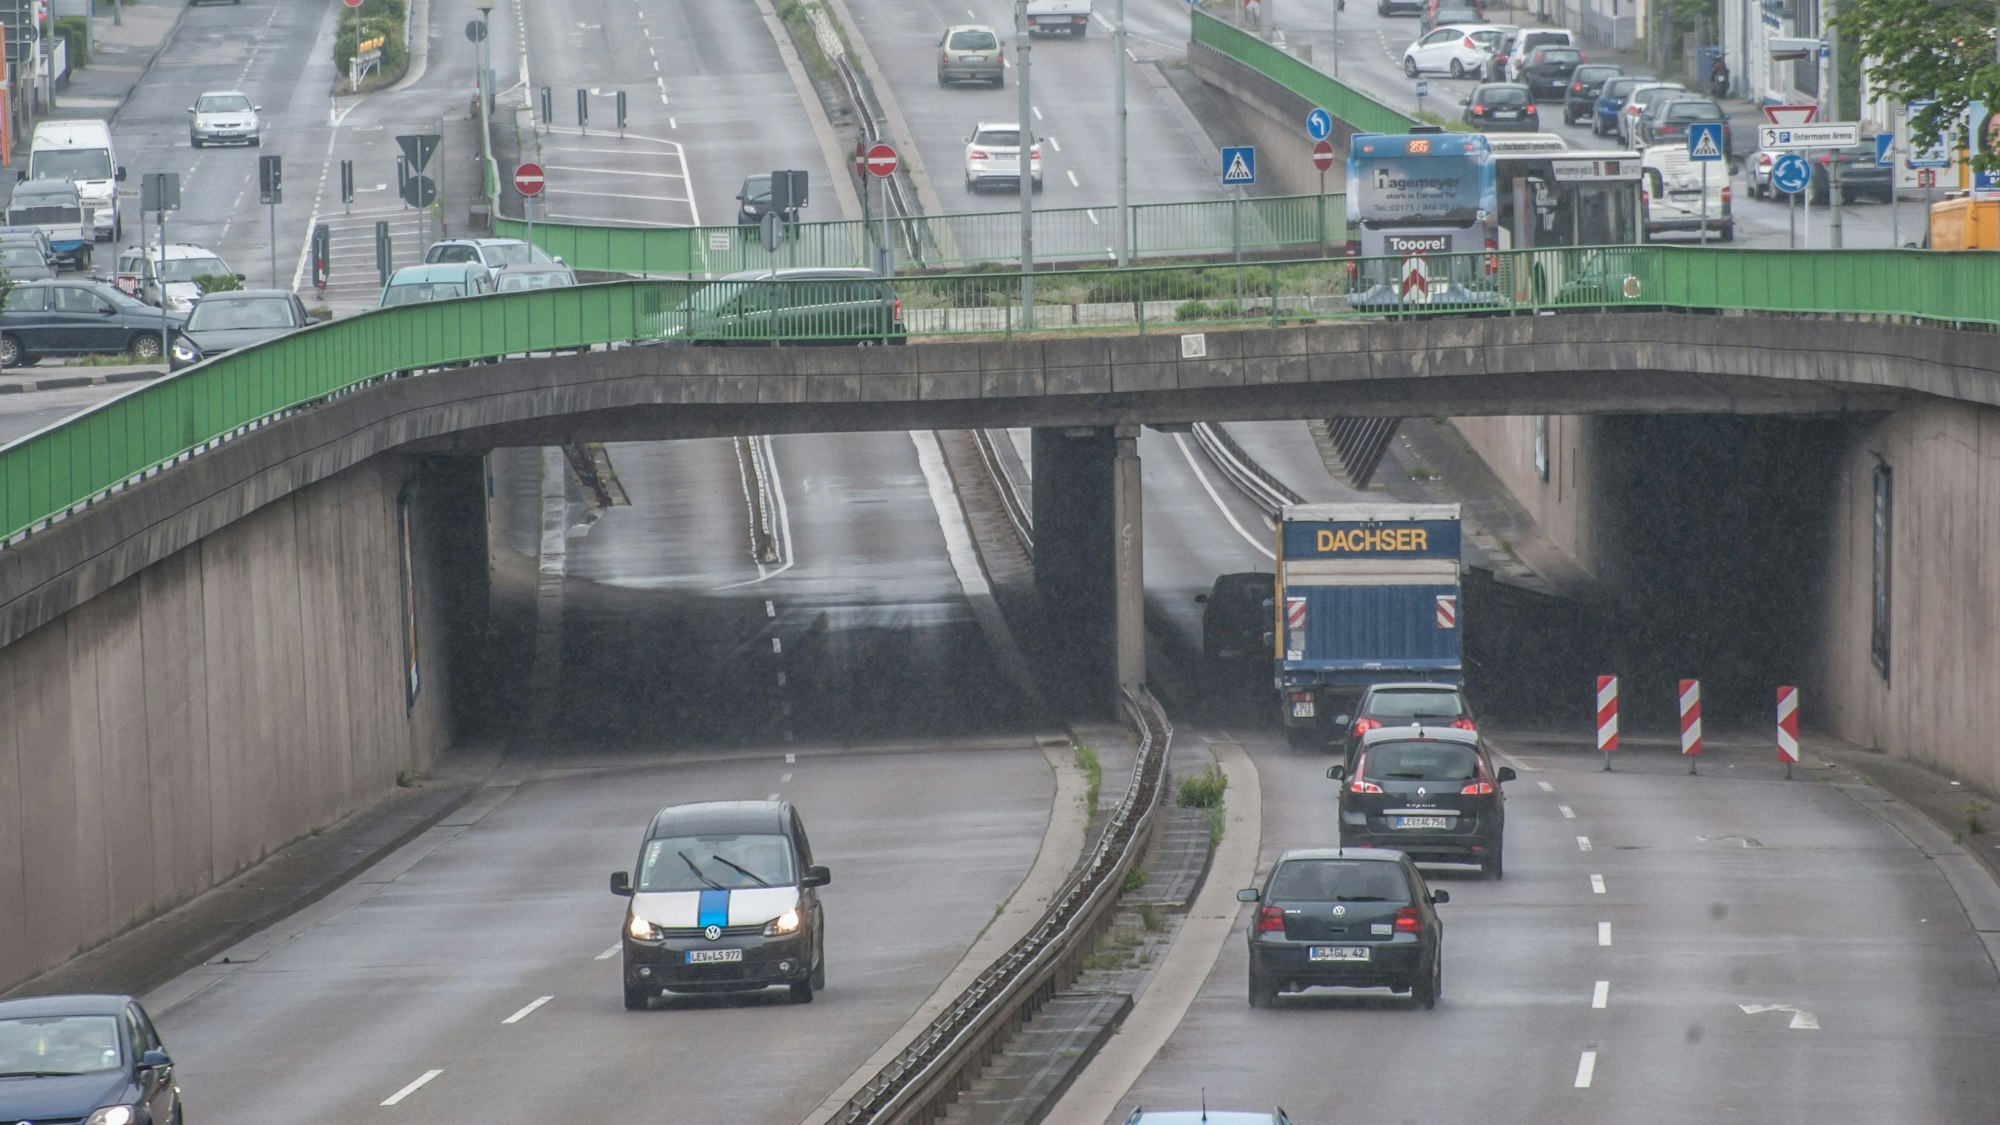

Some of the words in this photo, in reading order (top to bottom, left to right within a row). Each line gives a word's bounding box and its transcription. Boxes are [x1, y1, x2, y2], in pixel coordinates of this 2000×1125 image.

[1793, 132, 1831, 141] Ostermann
[1832, 131, 1853, 140] Arena
[1373, 168, 1460, 190] hagemeyer
[1390, 237, 1446, 251] Tooore!
[1317, 528, 1428, 552] DACHSER
[1402, 817, 1416, 826] LEV
[1421, 817, 1430, 826] AC
[1431, 817, 1445, 826] 756
[691, 952, 707, 962] LEV
[713, 951, 724, 961] LS
[725, 950, 740, 960] 977
[1316, 948, 1329, 958] GL
[1334, 948, 1347, 958] GL
[1352, 948, 1365, 958] 42
